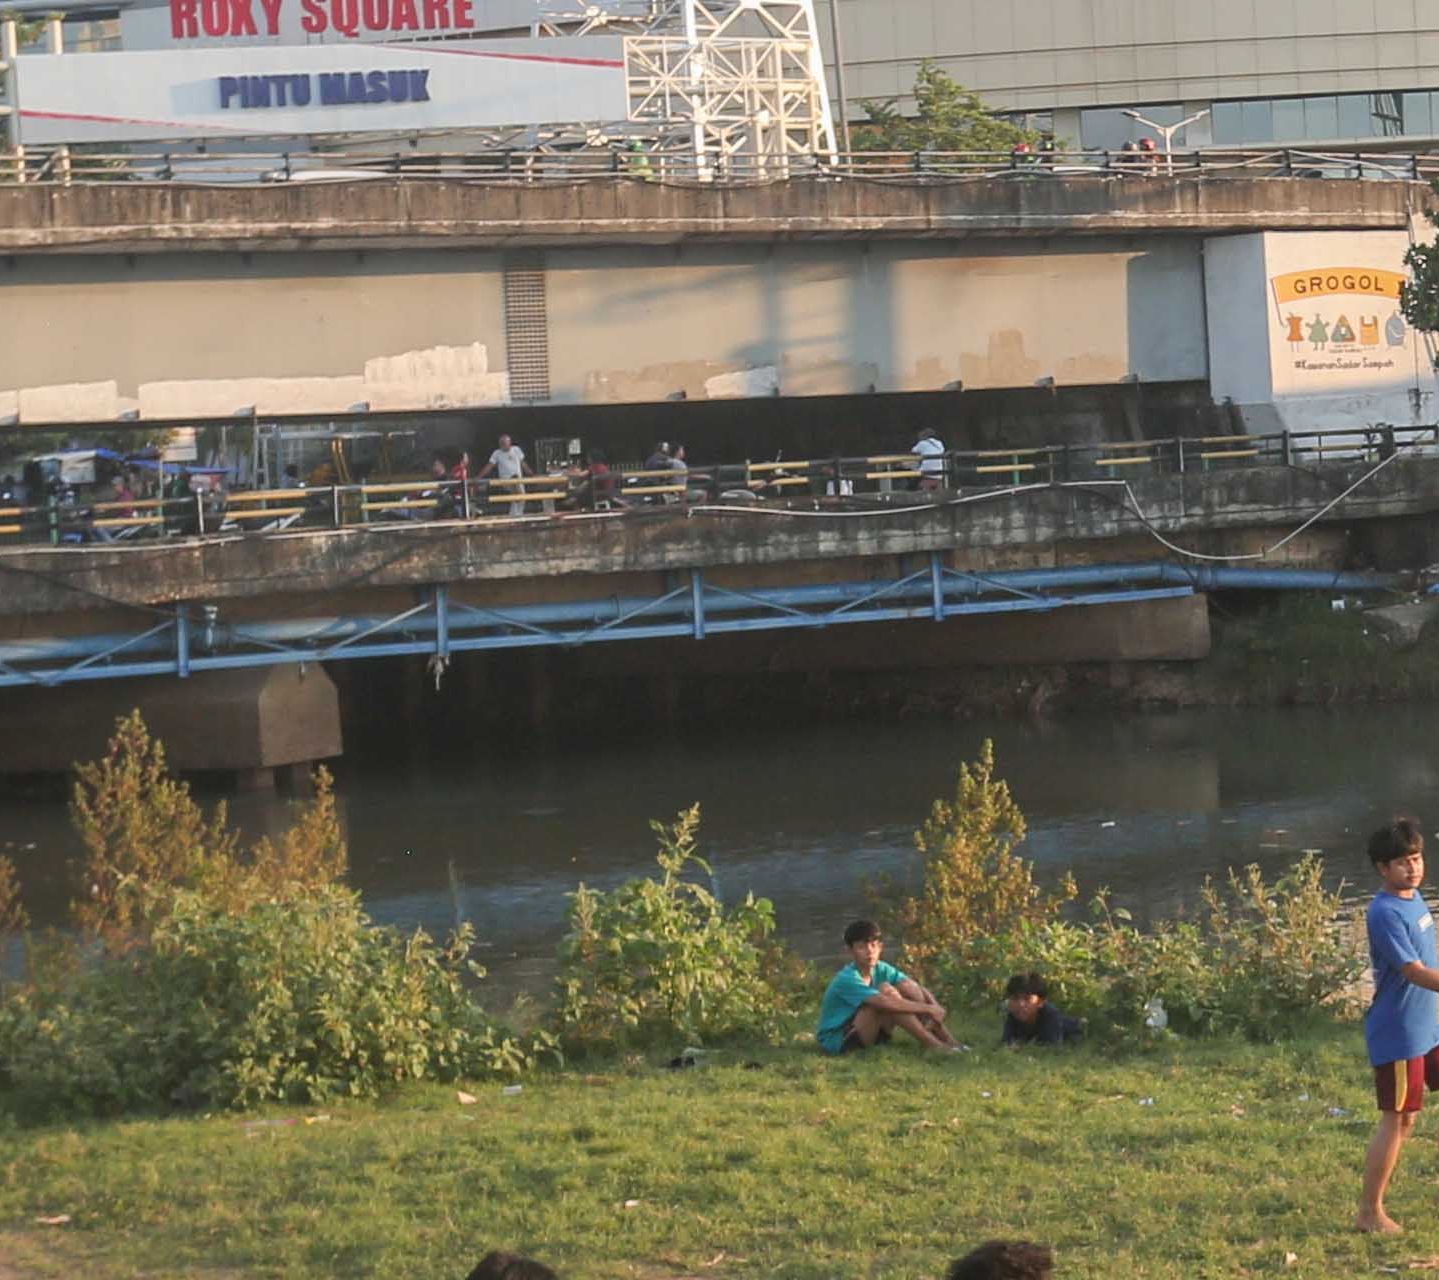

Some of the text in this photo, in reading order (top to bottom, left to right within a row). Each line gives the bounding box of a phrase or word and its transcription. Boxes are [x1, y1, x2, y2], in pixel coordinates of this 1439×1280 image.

[219, 69, 432, 109] PINTU MASUK
[1294, 275, 1384, 294] GROGOL
